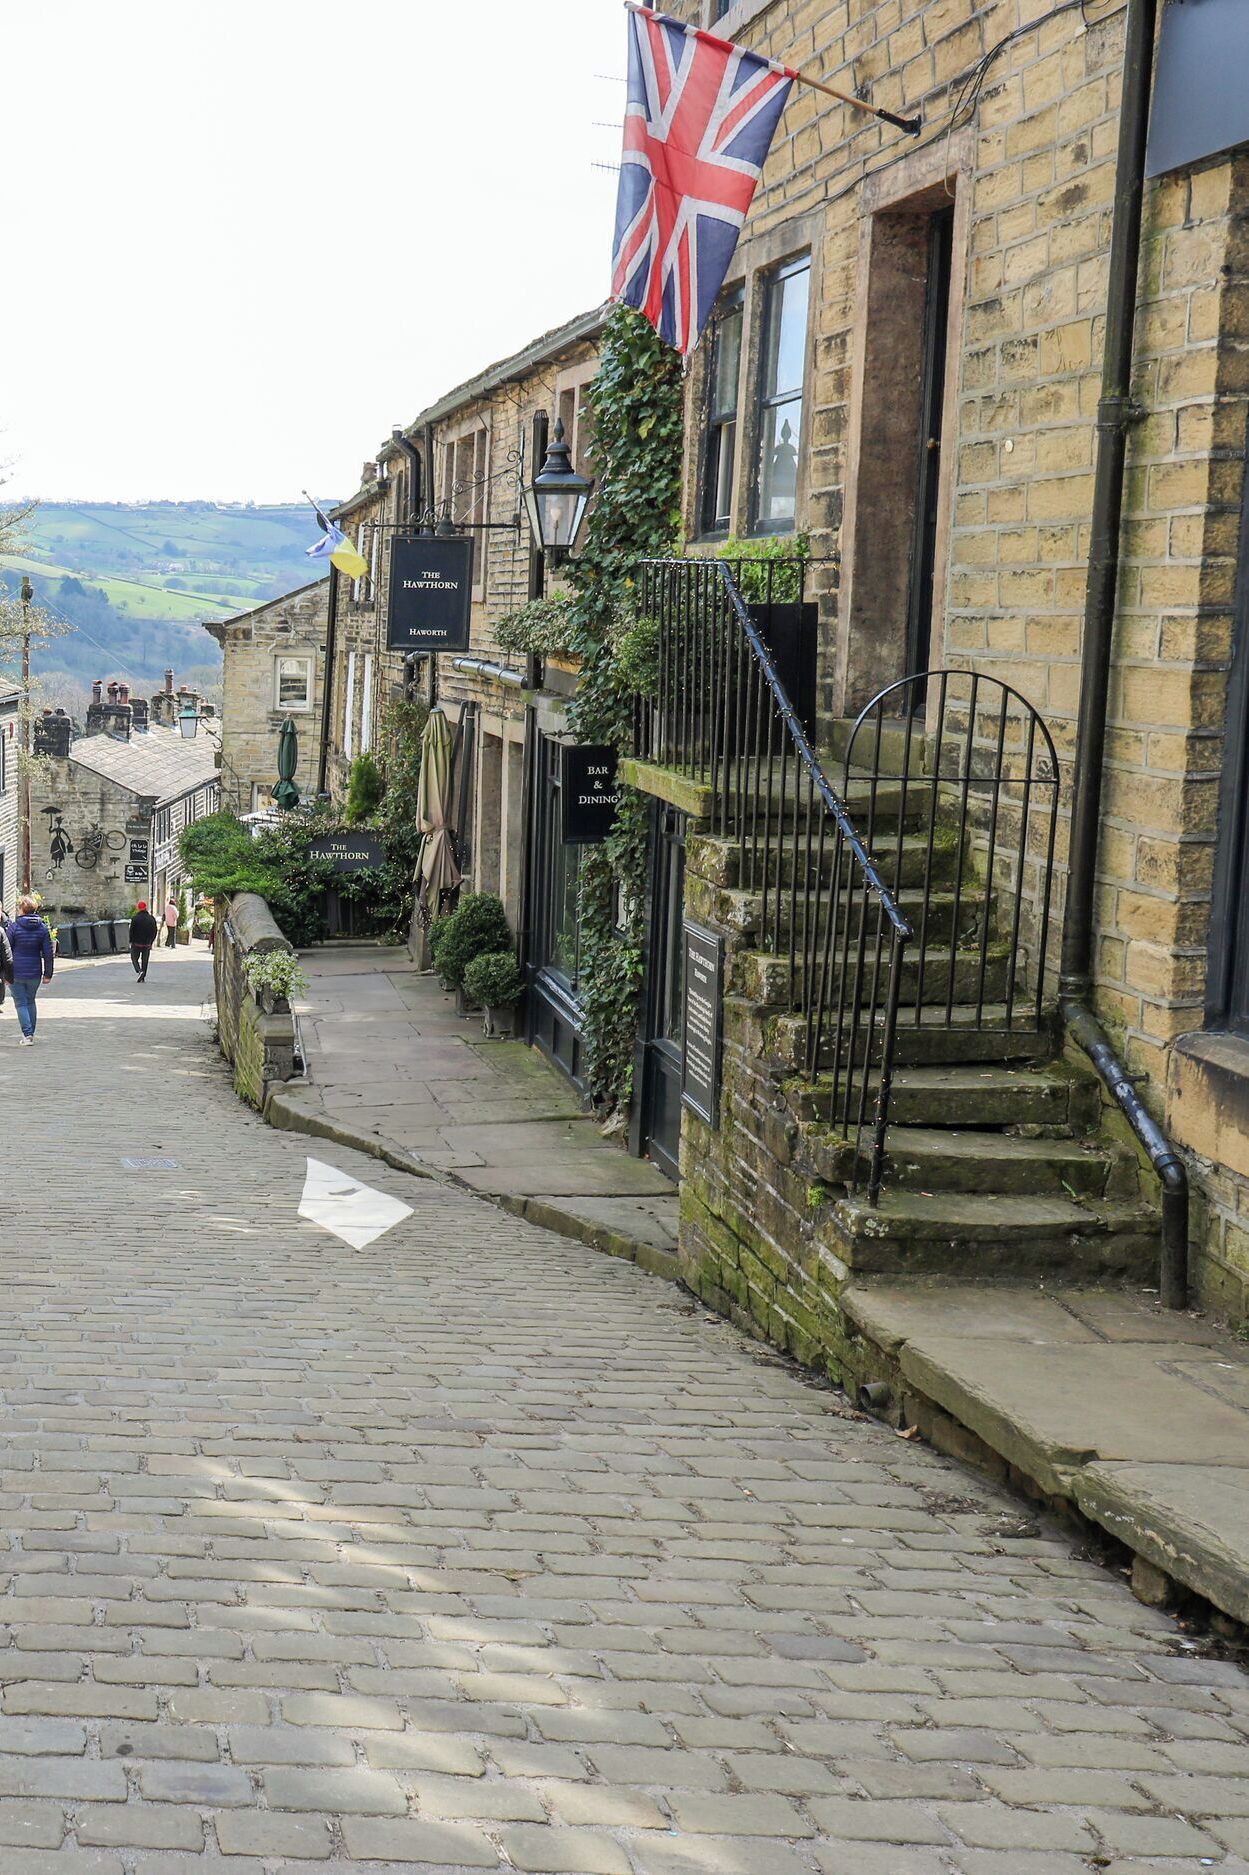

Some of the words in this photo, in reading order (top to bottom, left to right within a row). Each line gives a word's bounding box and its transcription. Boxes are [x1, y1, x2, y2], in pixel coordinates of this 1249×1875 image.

[421, 571, 441, 579] THE
[403, 580, 459, 590] HAWTHORN
[409, 628, 447, 636] HAWORTH
[587, 766, 609, 775] BAR
[593, 780, 603, 790] &
[578, 795, 619, 805] DINING
[330, 843, 347, 851] THE
[310, 850, 369, 860] HAWTHORN
